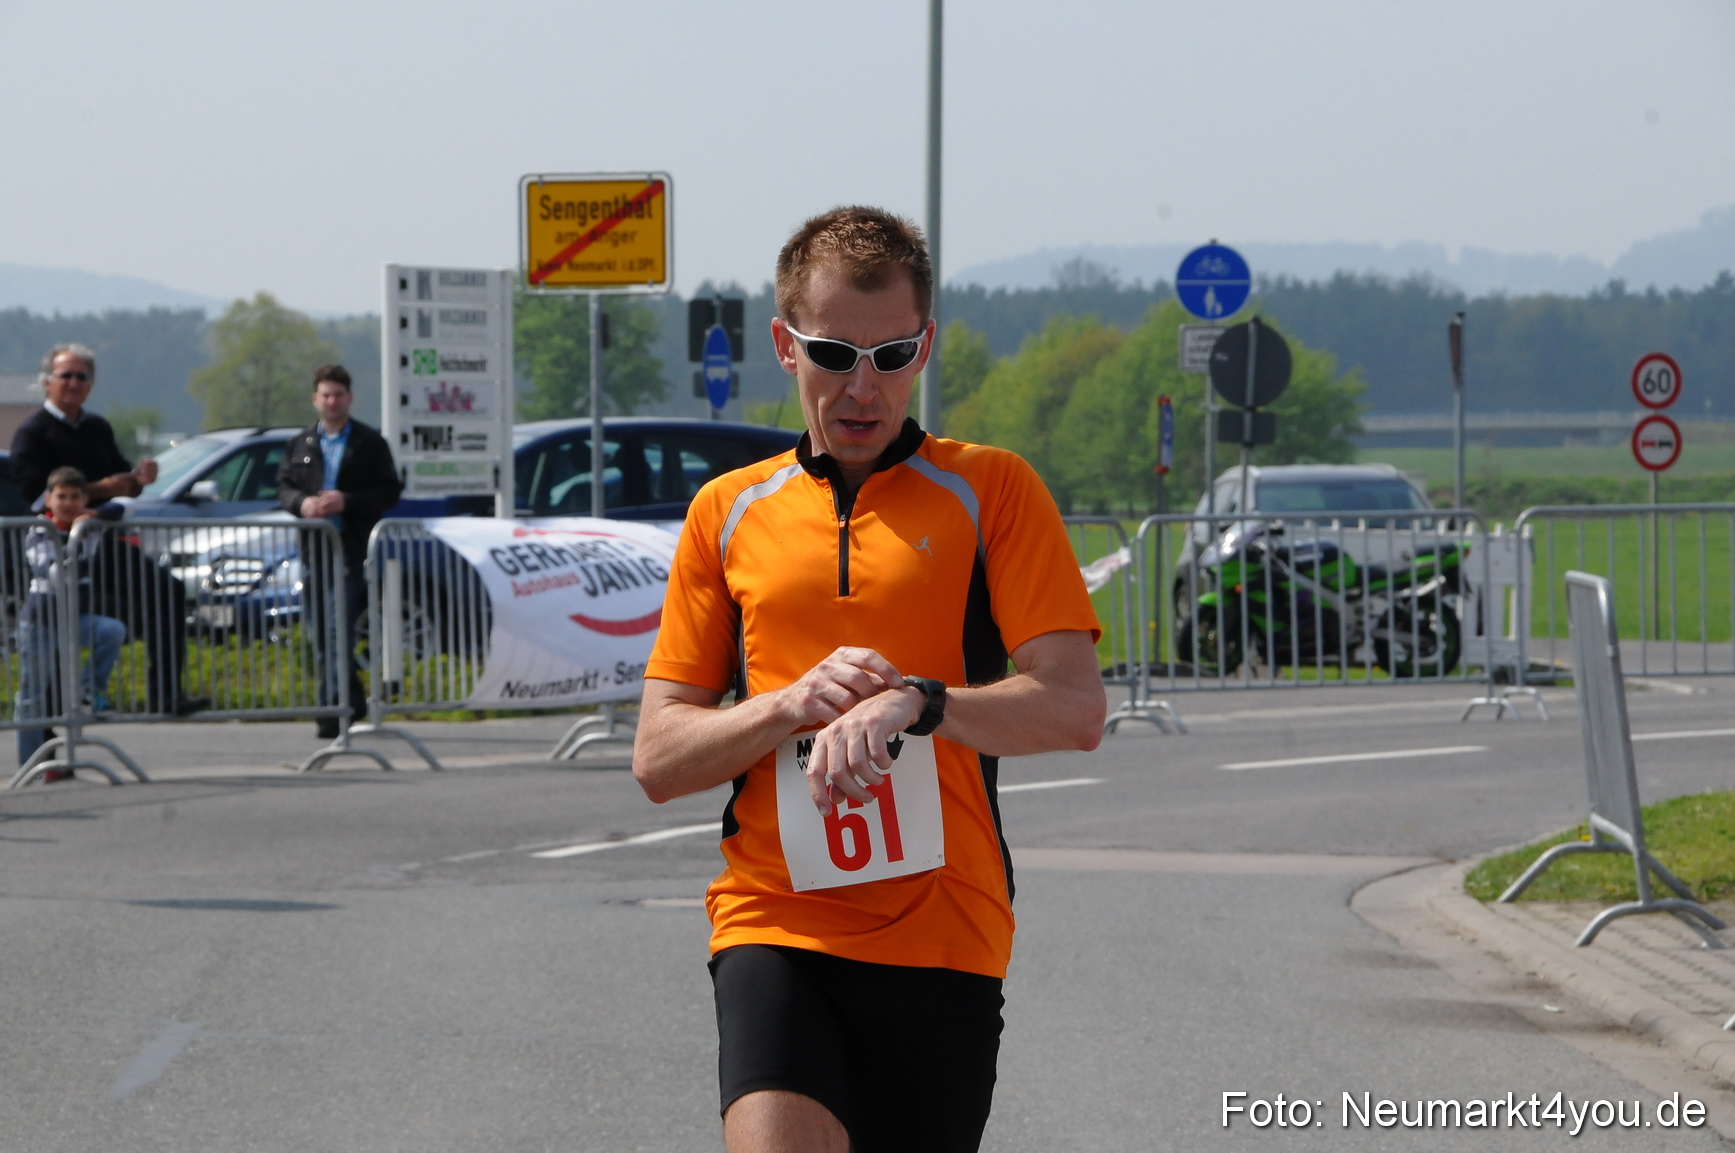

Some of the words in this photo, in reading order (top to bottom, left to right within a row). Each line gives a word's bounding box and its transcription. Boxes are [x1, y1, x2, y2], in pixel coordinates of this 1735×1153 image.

[539, 194, 653, 227] Sengenthal
[1643, 368, 1671, 395] 60
[511, 571, 580, 597] Autohaus
[501, 669, 599, 699] Neumarkt
[823, 773, 904, 872] 61
